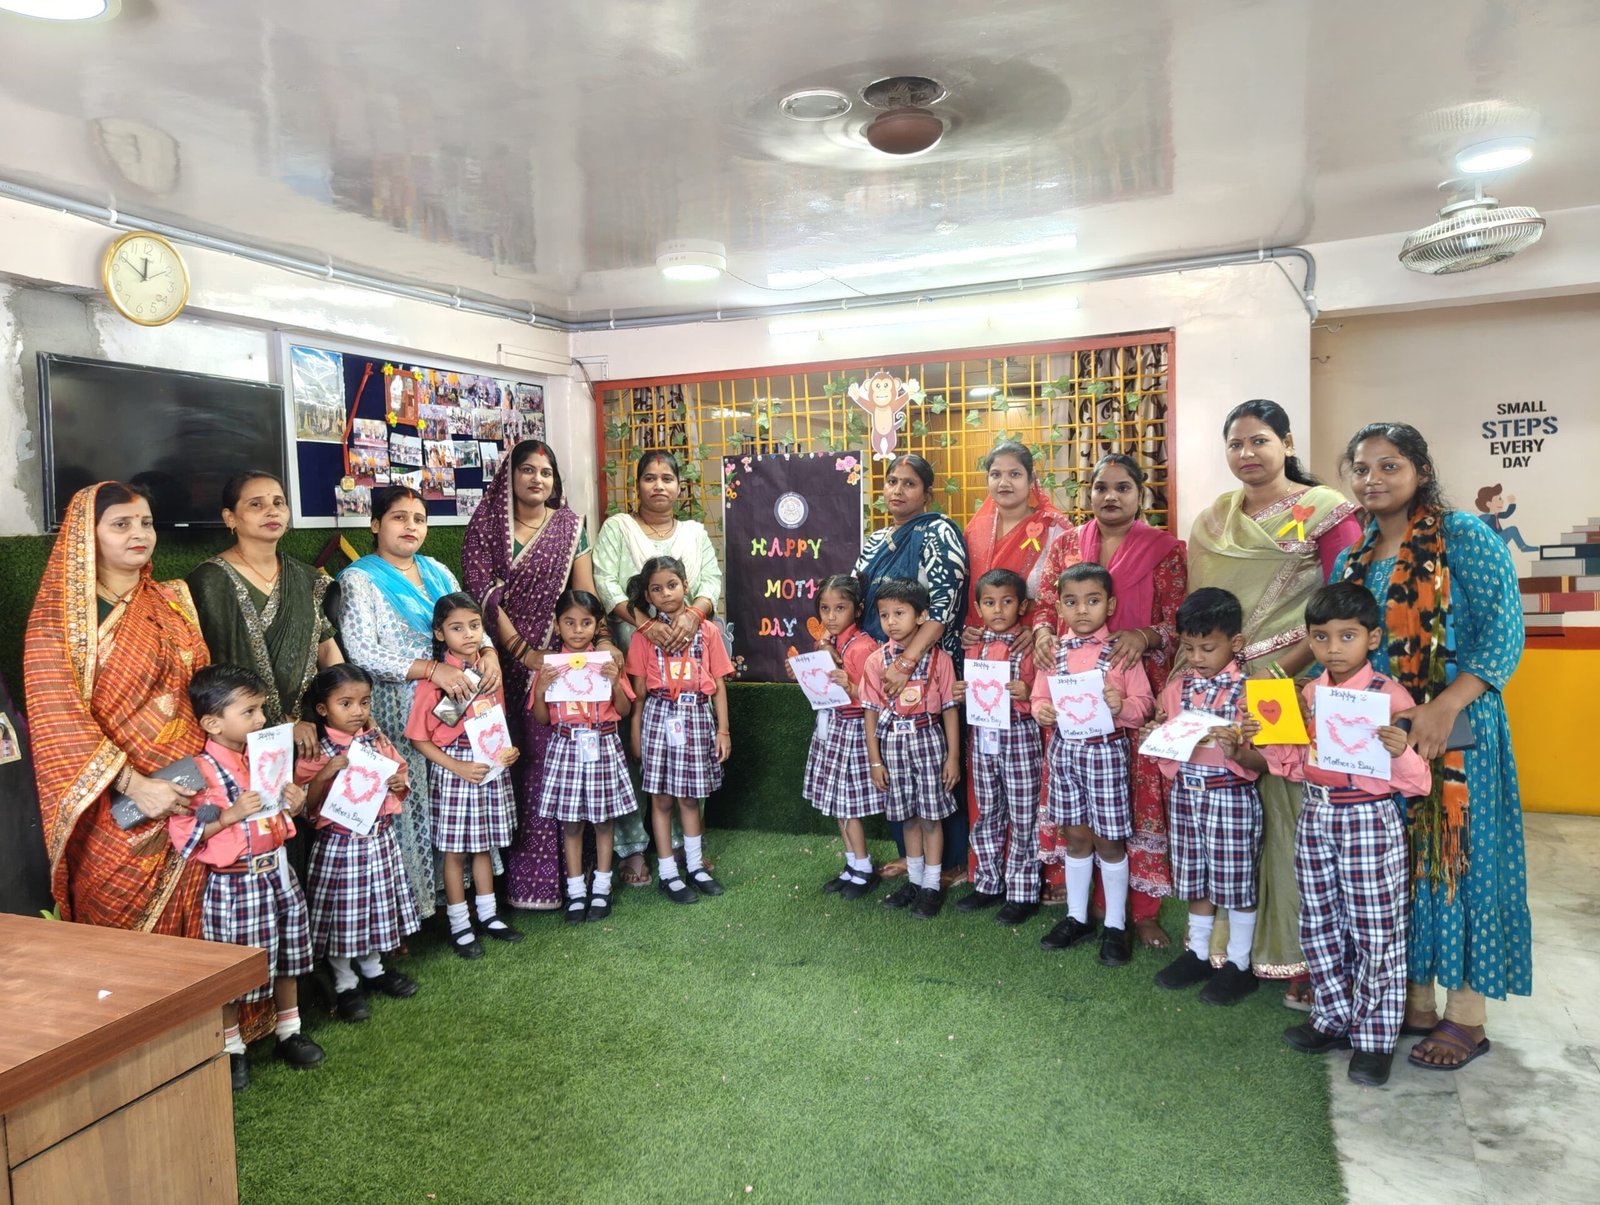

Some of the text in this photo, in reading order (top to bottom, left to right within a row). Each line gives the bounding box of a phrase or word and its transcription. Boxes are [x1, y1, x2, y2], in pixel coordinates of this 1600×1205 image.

[144, 242, 153, 257] 12
[167, 281, 175, 294] 3
[125, 293, 132, 305] 7
[136, 303, 143, 313] 6
[150, 301, 157, 314] 5
[1497, 400, 1547, 415] SMALL
[1481, 416, 1559, 440] STEPS
[1490, 438, 1545, 456] EVERY
[1502, 455, 1531, 469] DAY
[751, 537, 822, 559] HAPPY
[759, 617, 797, 637] DAY
[973, 661, 989, 670] Happy
[1058, 677, 1077, 685] Happy
[1329, 689, 1356, 703] Happy
[1089, 726, 1102, 735] Day
[1323, 755, 1376, 774] Mother's Day
[351, 811, 364, 827] Day
